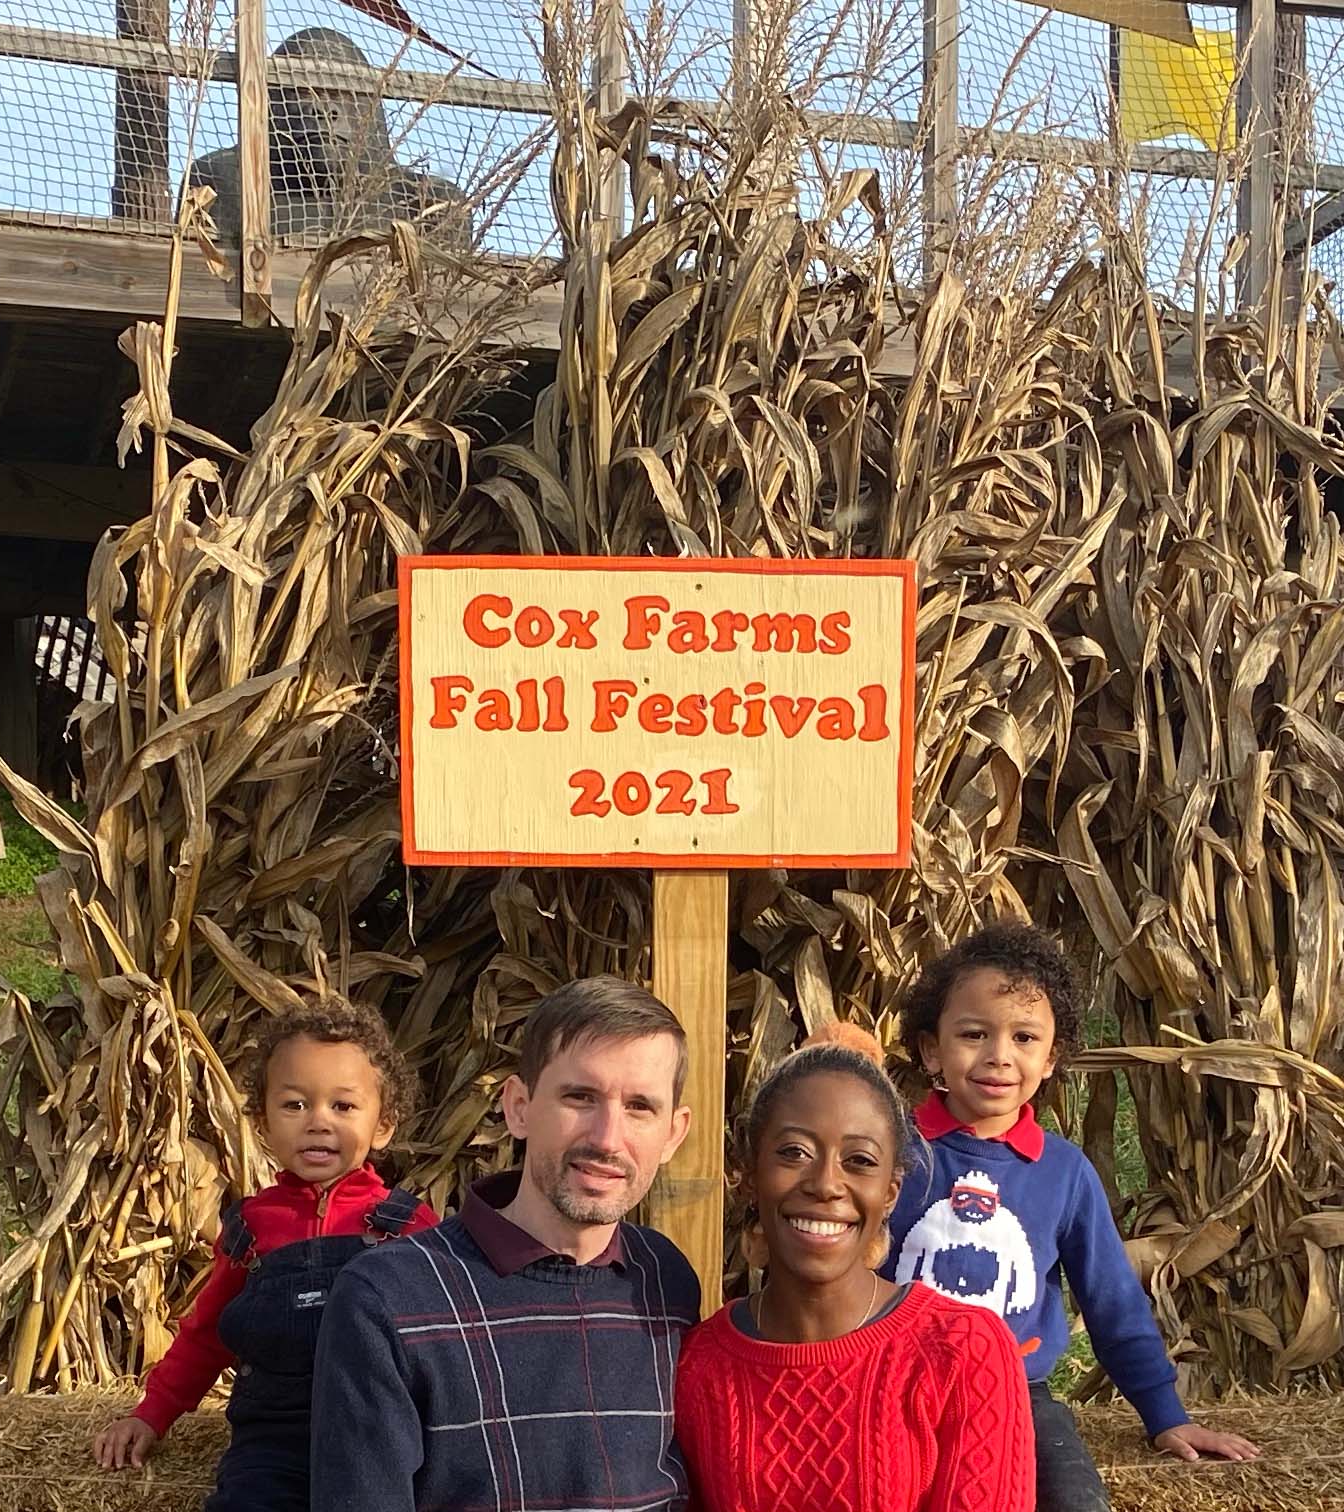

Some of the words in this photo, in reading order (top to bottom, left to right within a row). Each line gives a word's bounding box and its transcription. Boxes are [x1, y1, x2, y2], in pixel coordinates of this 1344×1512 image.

[462, 593, 600, 650] Cox
[622, 594, 852, 655] Farms
[428, 674, 570, 733] Fall
[590, 678, 891, 742] Festival
[567, 767, 740, 818] 2021
